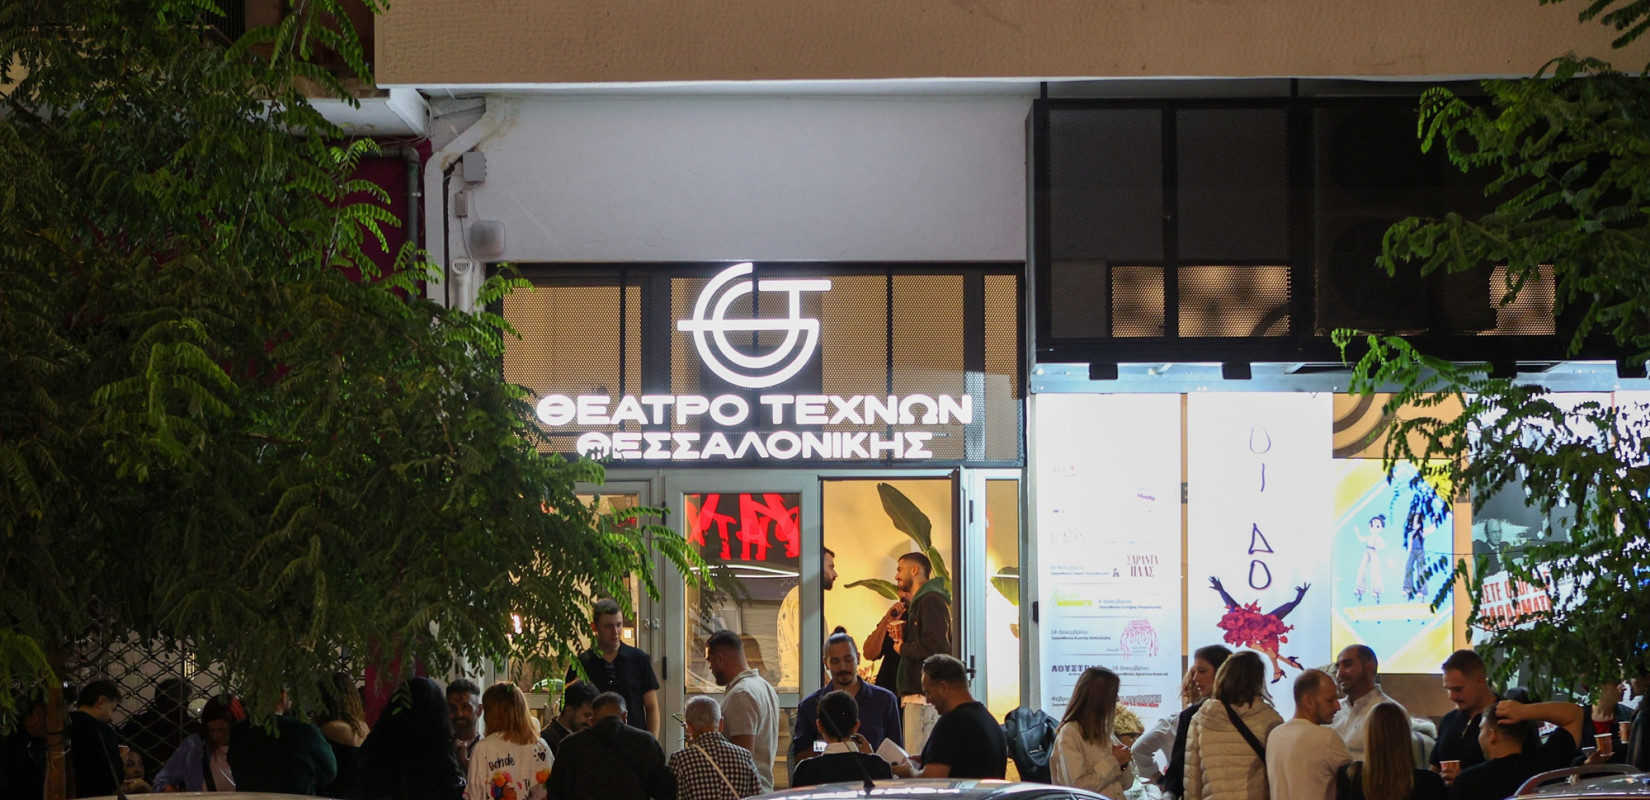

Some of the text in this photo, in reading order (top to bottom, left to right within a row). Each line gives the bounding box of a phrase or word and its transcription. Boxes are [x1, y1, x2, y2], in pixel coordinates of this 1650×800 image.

[537, 394, 973, 426] ΘΕΑΤΡΟ ΤΕΧΝΩΝ
[576, 431, 933, 460] ΘΕΣΣΑΛΟΝΙΚΗΣ
